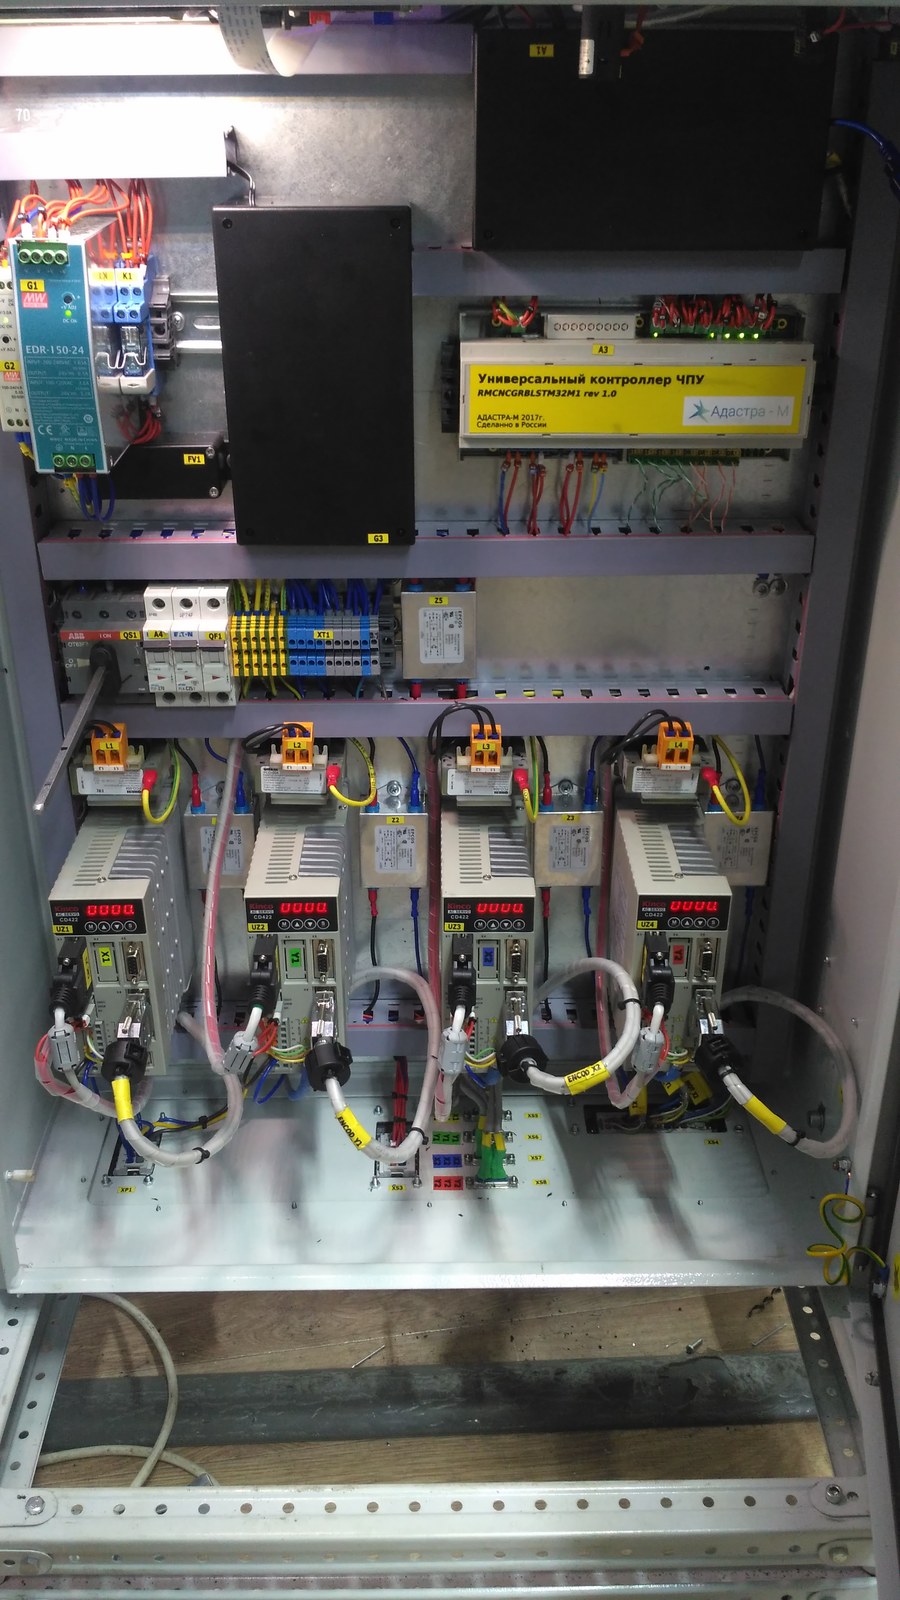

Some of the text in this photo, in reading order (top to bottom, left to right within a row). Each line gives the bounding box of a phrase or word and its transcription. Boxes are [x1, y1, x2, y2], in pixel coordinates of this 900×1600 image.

[536, 46, 548, 56] A1
[15, 108, 31, 122] 70
[122, 272, 133, 280] K1
[26, 280, 39, 290] G1
[26, 345, 85, 355] EDR-150-24
[598, 346, 609, 354] A3
[4, 361, 16, 370] G2
[478, 373, 705, 388] Универсальный контроллер ЧПУ
[477, 389, 618, 398] RMCNCGRBLSTM32M1 rev 1.0
[710, 405, 766, 420] Адастра
[476, 414, 545, 422] АДАСТРА-М 2017г.
[476, 422, 514, 430] Сделанно
[521, 421, 547, 429] России
[188, 455, 202, 463] FV1
[374, 534, 384, 543] G3
[68, 632, 85, 640] ABB
[123, 632, 138, 640] QS1
[317, 631, 330, 639] XT1
[101, 951, 111, 963] X1
[291, 952, 300, 964] Y1
[567, 1063, 602, 1083] ENCOD_X2
[337, 1116, 363, 1147] ENCOD_Y1
